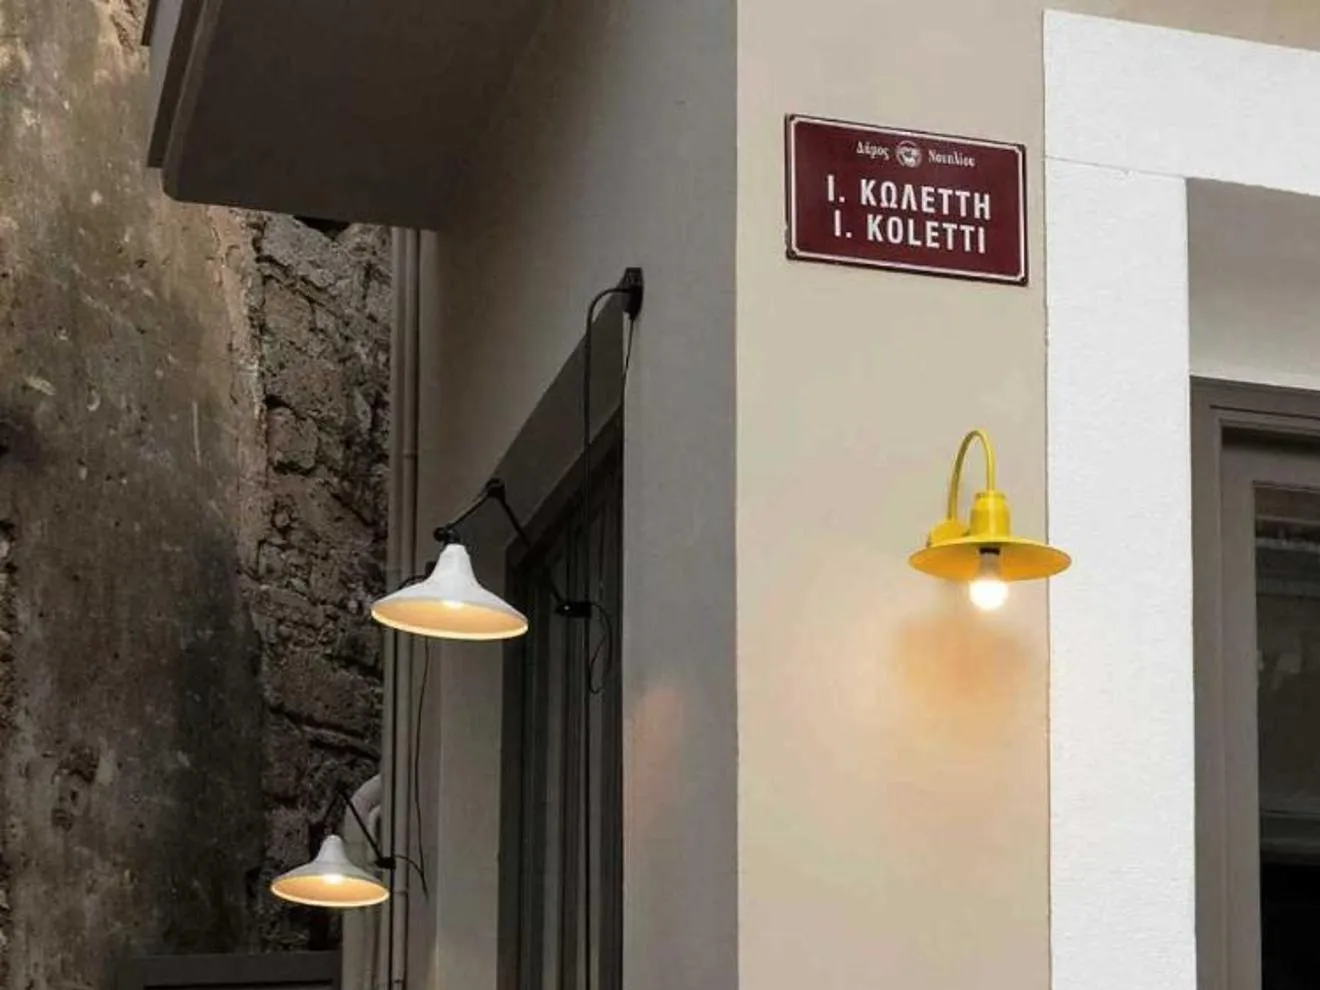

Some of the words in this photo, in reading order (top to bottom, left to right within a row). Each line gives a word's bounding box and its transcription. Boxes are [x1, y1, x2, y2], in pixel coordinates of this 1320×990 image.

[827, 174, 846, 203] Ι.
[860, 178, 991, 221] ΚΩΛΕΤΤΗ
[834, 209, 852, 239] I.
[866, 213, 986, 254] KOLETTI
